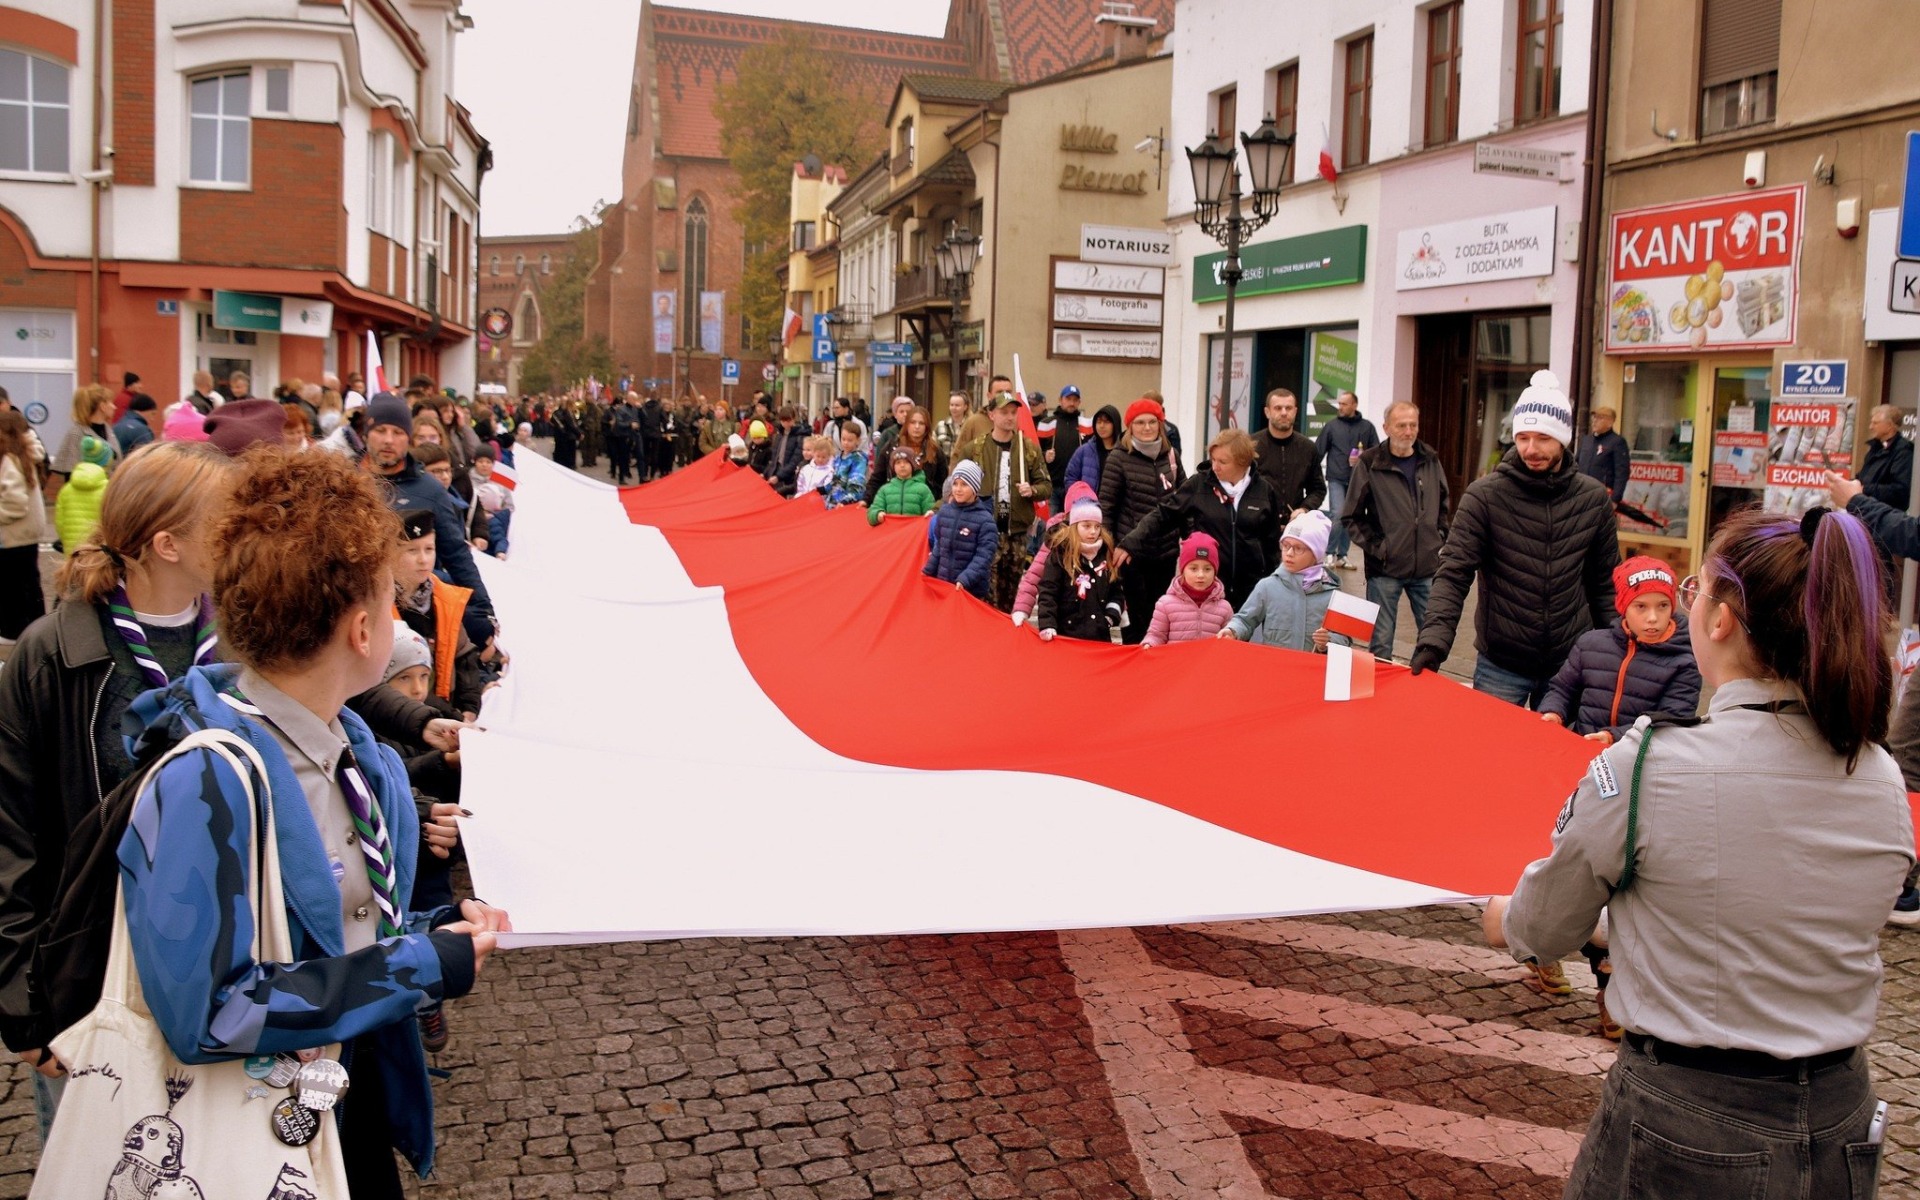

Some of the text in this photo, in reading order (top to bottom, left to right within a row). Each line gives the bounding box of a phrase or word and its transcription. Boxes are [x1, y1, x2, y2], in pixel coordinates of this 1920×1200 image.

[1061, 124, 1118, 151] Willa
[1060, 164, 1148, 193] Pierrot
[1483, 222, 1508, 238] BUTIK
[1086, 237, 1171, 255] NOTARIUSZ
[1455, 236, 1539, 259] Z ODZIEŻĄ DAMSKĄ
[1619, 210, 1788, 271] KANTOR
[1466, 257, 1524, 274] I DODATKAMI
[1075, 265, 1148, 291] Pierrot
[1100, 298, 1148, 310] Fotografia
[817, 340, 832, 359] P
[725, 362, 737, 376] P
[1796, 365, 1832, 385] 20
[1809, 385, 1842, 394] GŁÓWNY
[1776, 408, 1831, 424] KANTOR
[1630, 465, 1679, 481] XCHANGE
[299, 1096, 334, 1112] PARK
[301, 1088, 338, 1103] LINKIN
[278, 1100, 307, 1145] TOLKIEN
[292, 1105, 305, 1125] WHAT
[274, 1114, 295, 1143] ABOUT
